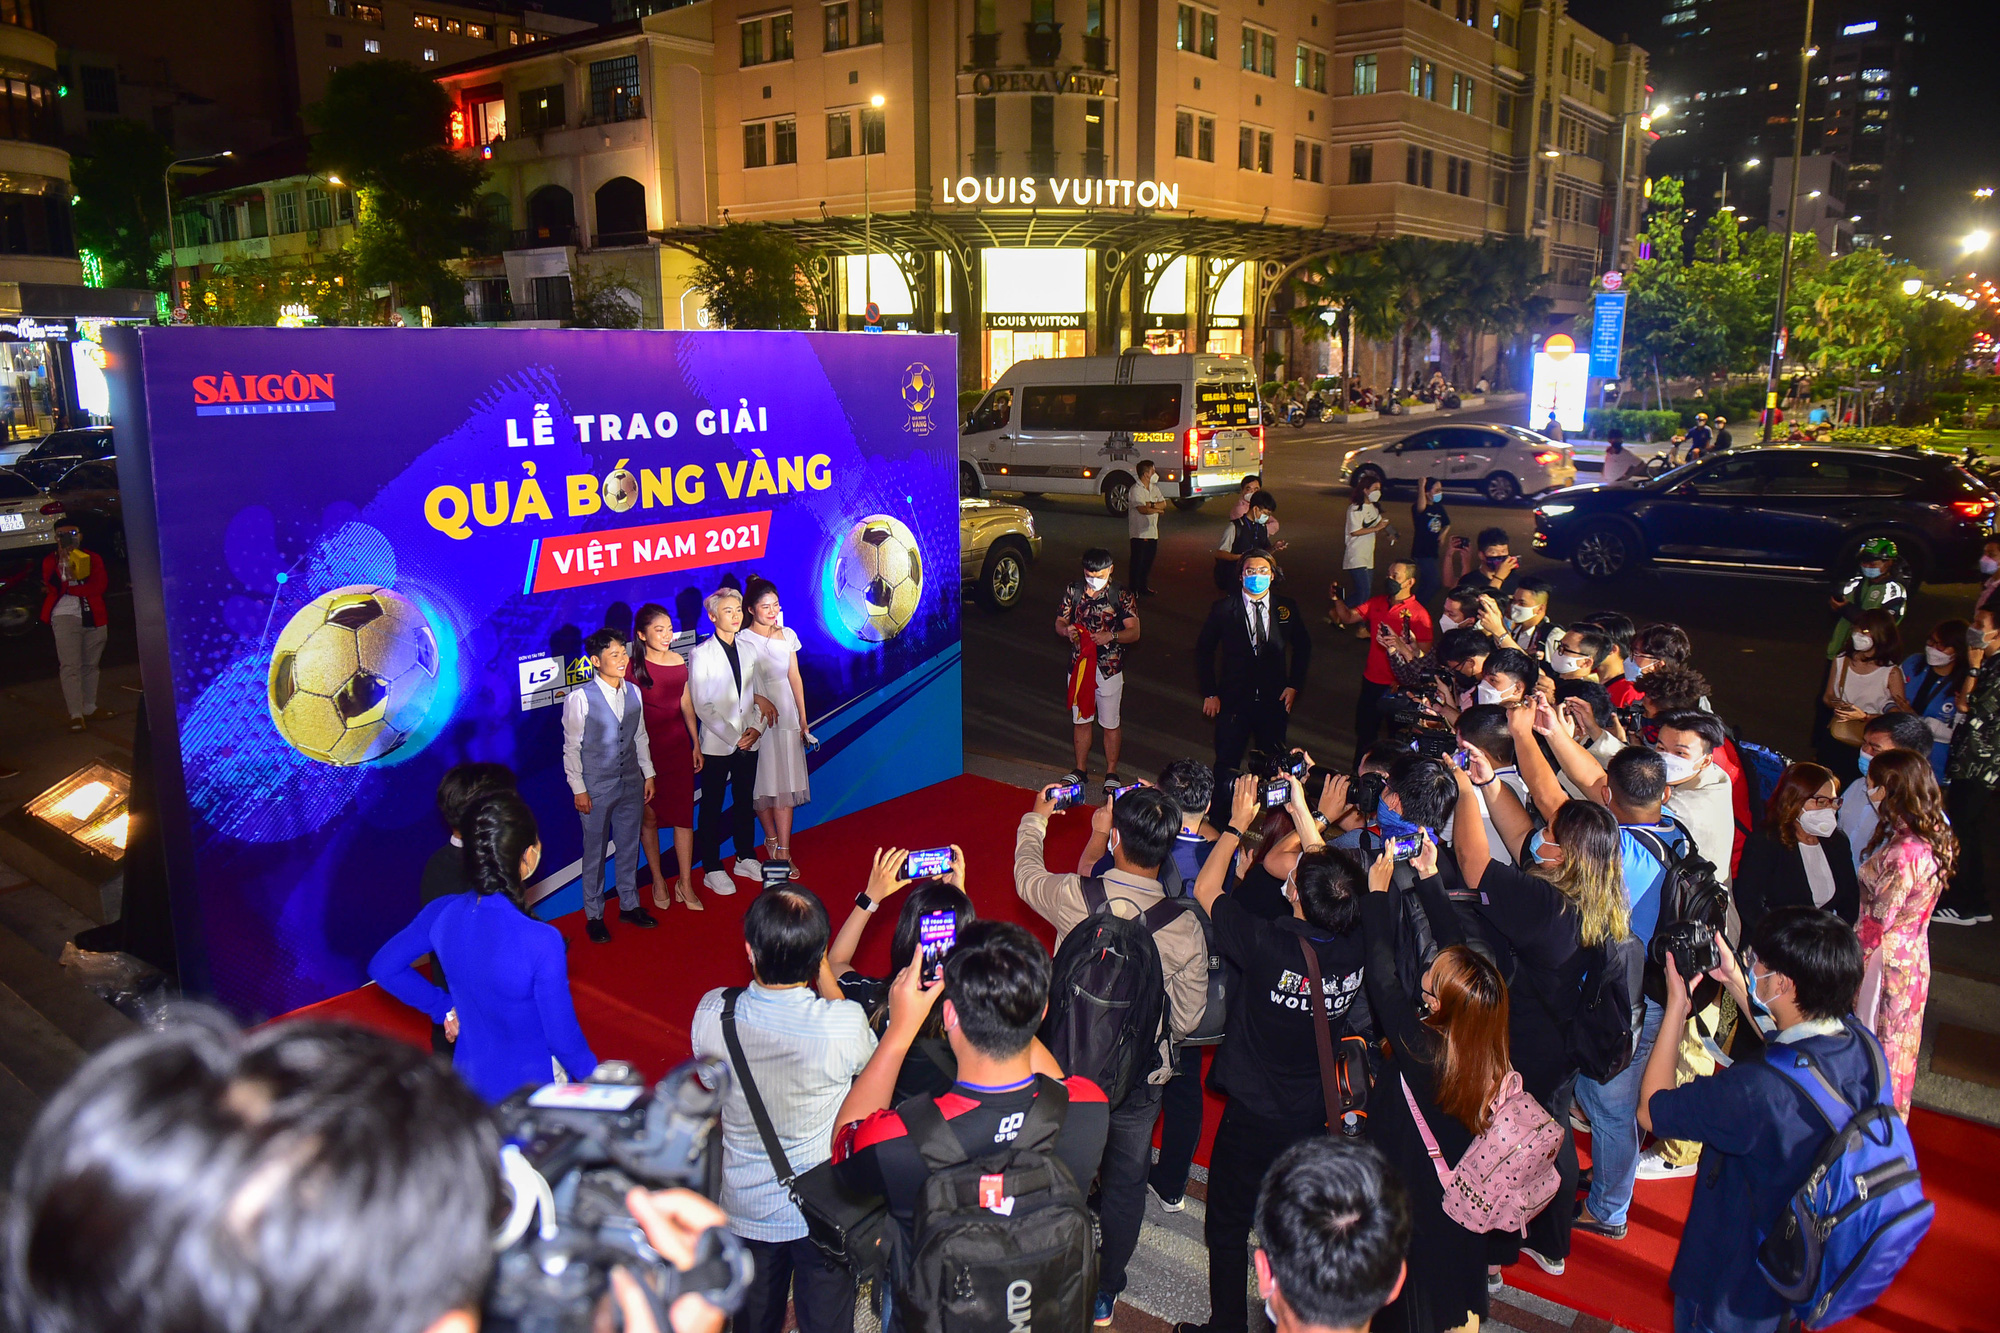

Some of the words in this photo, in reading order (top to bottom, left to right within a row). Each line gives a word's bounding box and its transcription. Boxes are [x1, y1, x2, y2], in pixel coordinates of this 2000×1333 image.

[1055, 72, 1106, 96] VIEW
[943, 176, 1037, 205] LOUIS
[1049, 177, 1179, 209] VUITTON
[992, 315, 1028, 328] LOUIS
[1030, 315, 1080, 328] VUITTON
[192, 369, 336, 404] SÀIGÒN
[506, 403, 556, 448] LỄ
[574, 411, 679, 443] TRAO
[696, 398, 768, 436] GIẢI
[423, 461, 553, 540] QUẢ
[566, 458, 705, 518] BÓNG
[715, 448, 832, 500] VÀNG
[552, 540, 624, 577] VIỆT
[632, 534, 697, 564] NAM
[705, 524, 761, 556] 2021
[529, 669, 551, 684] LS
[567, 669, 593, 683] TSN
